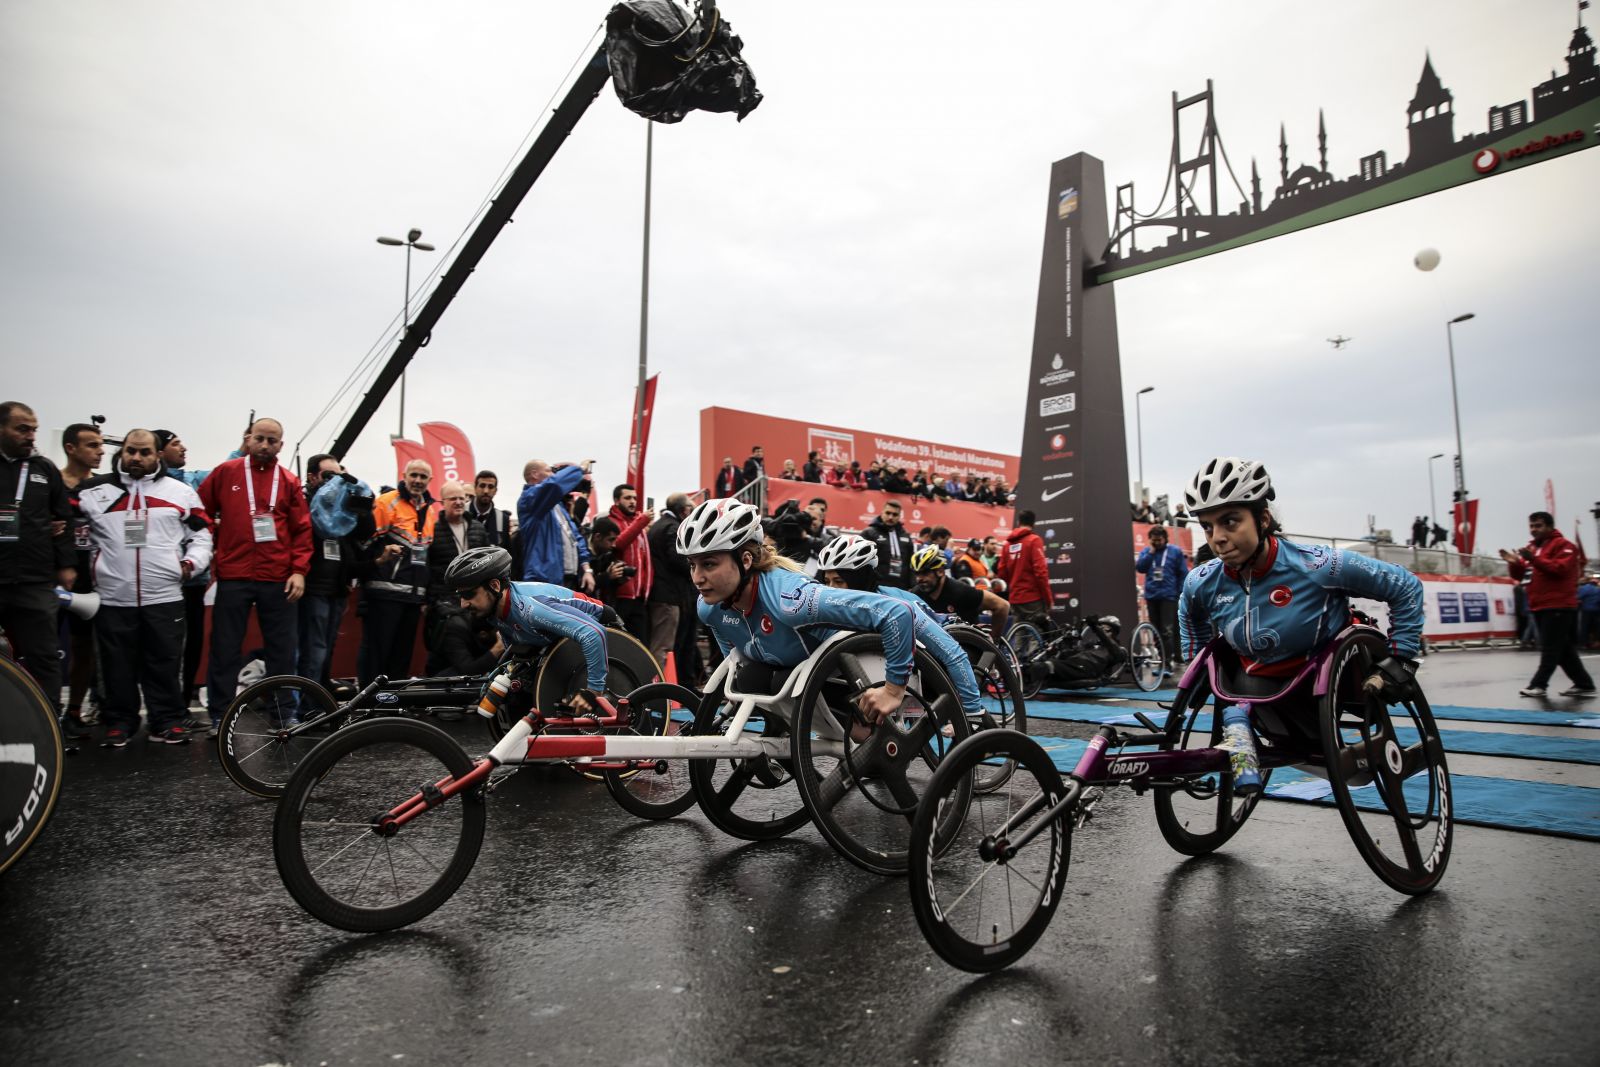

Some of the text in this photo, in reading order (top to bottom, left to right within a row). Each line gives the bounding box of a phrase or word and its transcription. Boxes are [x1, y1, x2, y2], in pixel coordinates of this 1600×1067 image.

[1503, 129, 1584, 161] vodafone
[440, 444, 461, 482] one
[1112, 761, 1145, 775] DRAFT
[1424, 764, 1449, 873] CORIMA
